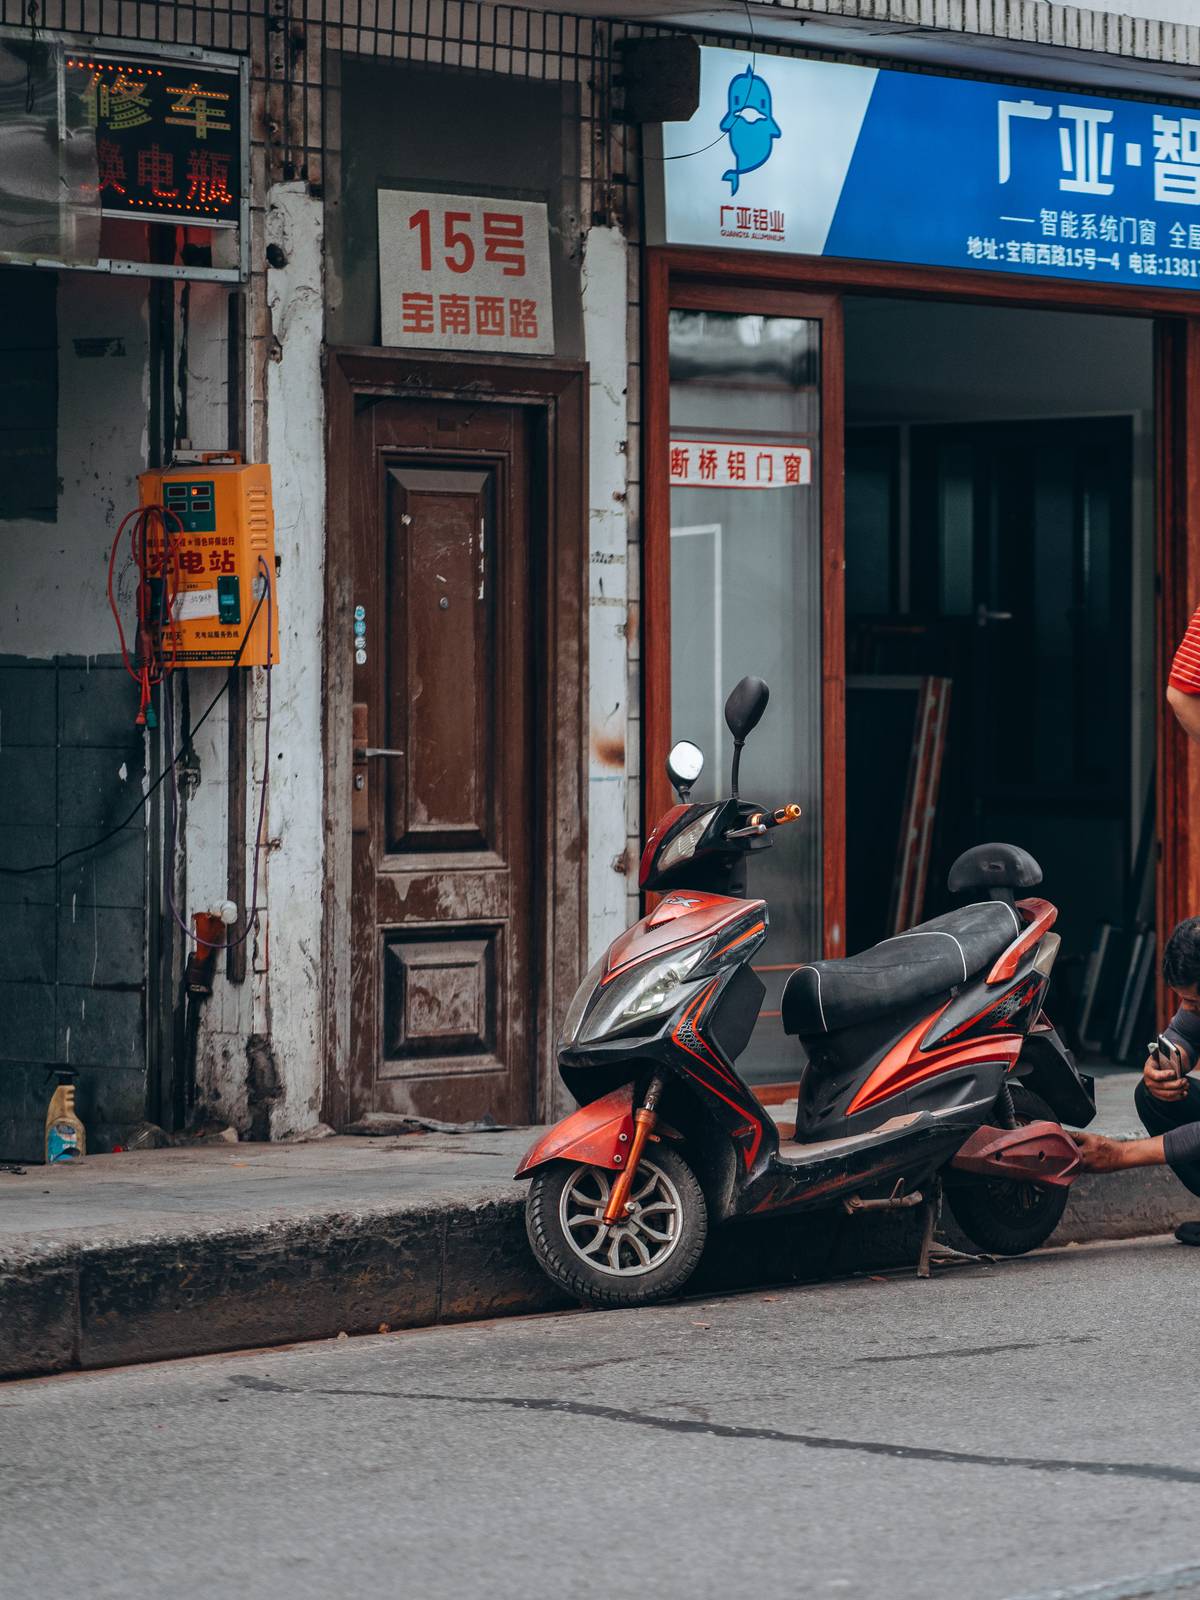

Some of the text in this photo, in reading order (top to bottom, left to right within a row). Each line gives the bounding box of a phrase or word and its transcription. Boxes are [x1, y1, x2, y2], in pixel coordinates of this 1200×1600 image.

[80, 72, 232, 139] 修车
[720, 205, 785, 233] 广亚铝业
[1040, 208, 1156, 246] 智能系统门窗
[409, 209, 526, 277] 15号
[402, 292, 538, 339] 宝南西路
[670, 447, 802, 484] 断桥铝门窗
